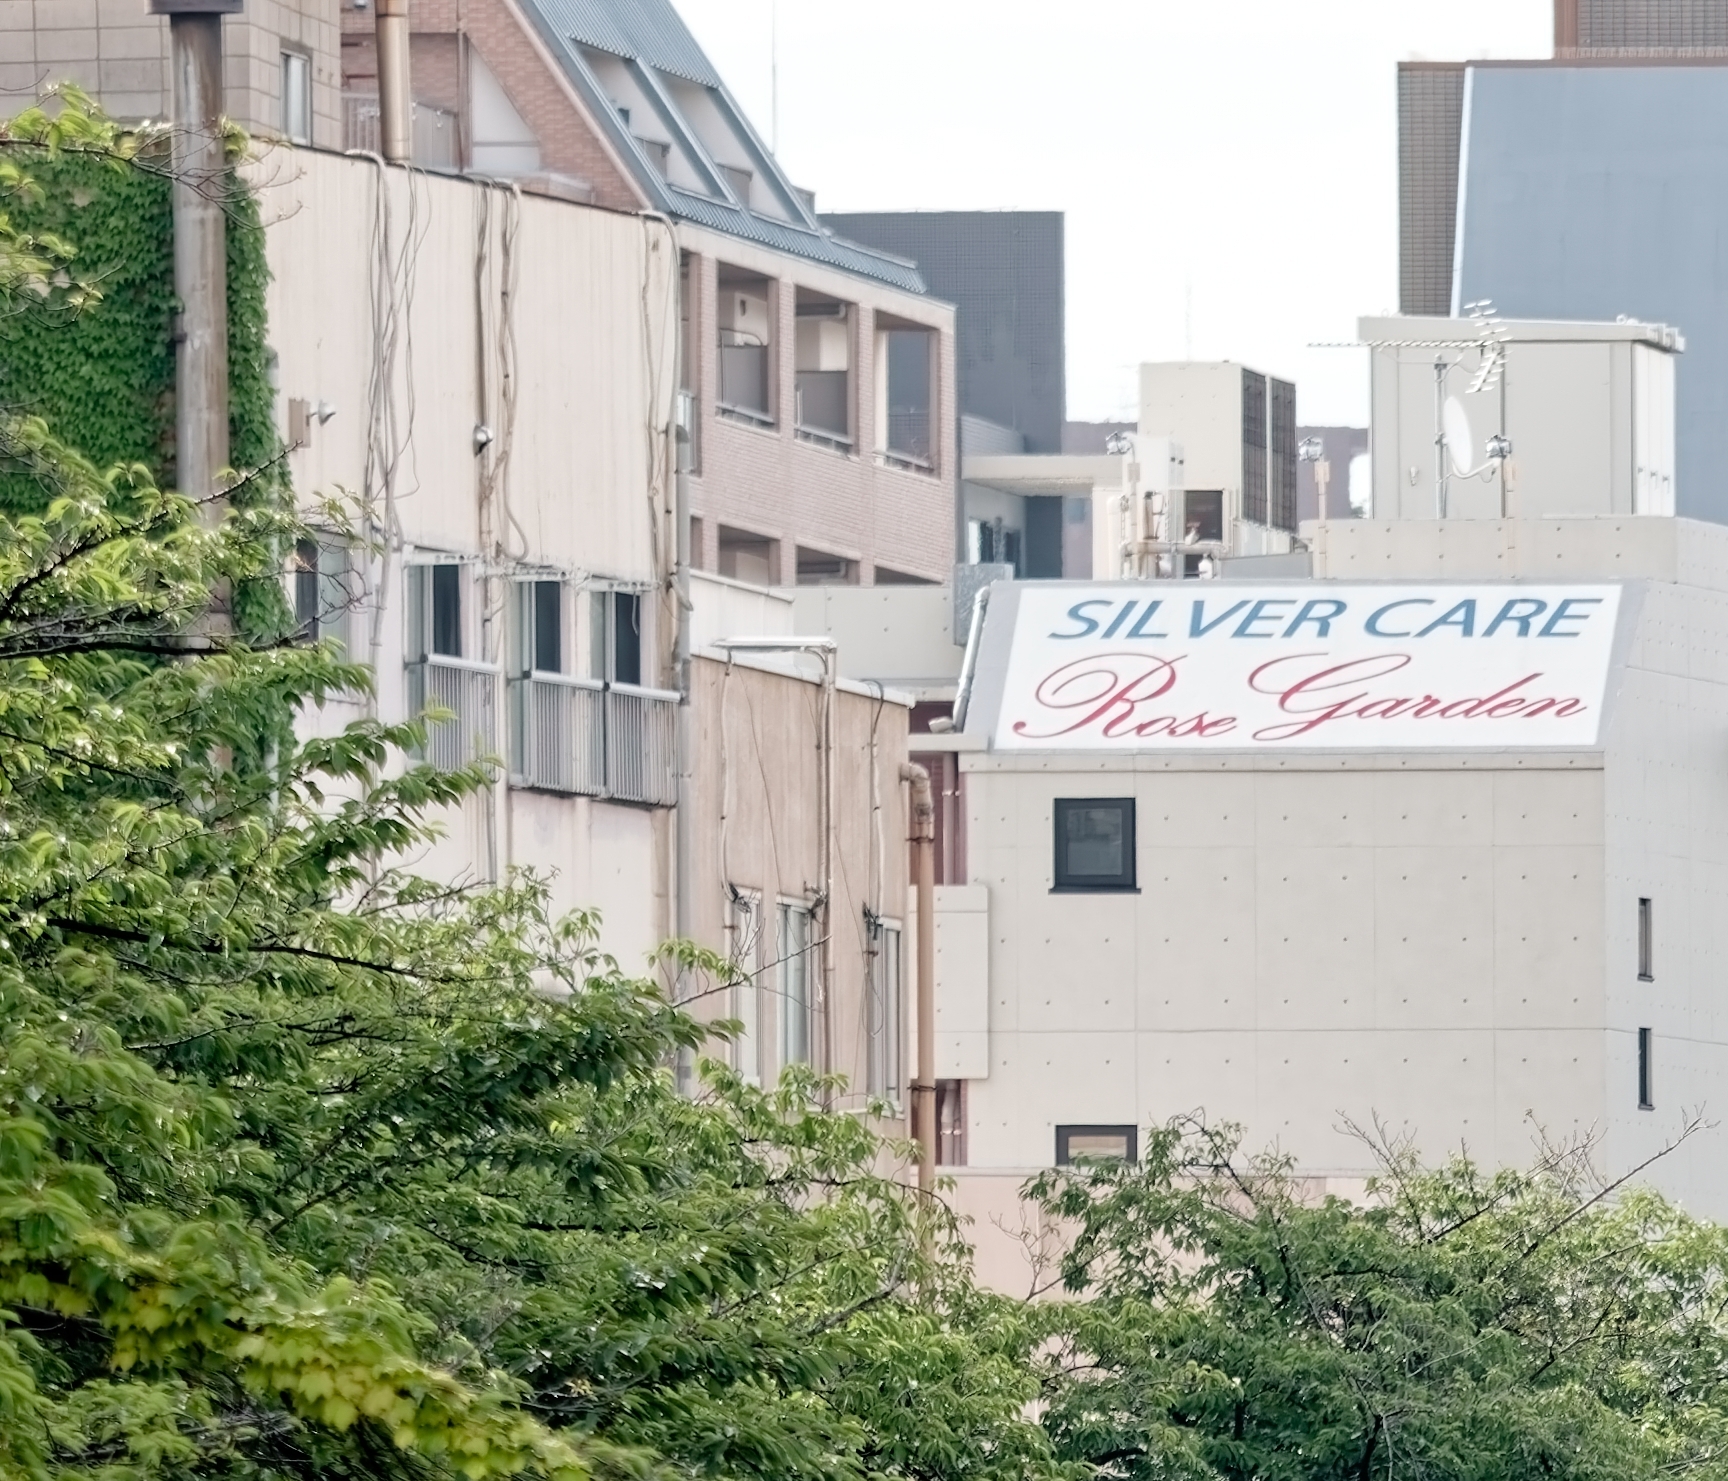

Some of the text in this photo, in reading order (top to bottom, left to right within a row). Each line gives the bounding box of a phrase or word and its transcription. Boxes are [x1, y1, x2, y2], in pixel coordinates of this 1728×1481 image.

[1048, 597, 1604, 640] SILVER CARE
[1012, 652, 1588, 741] Rose Garden
